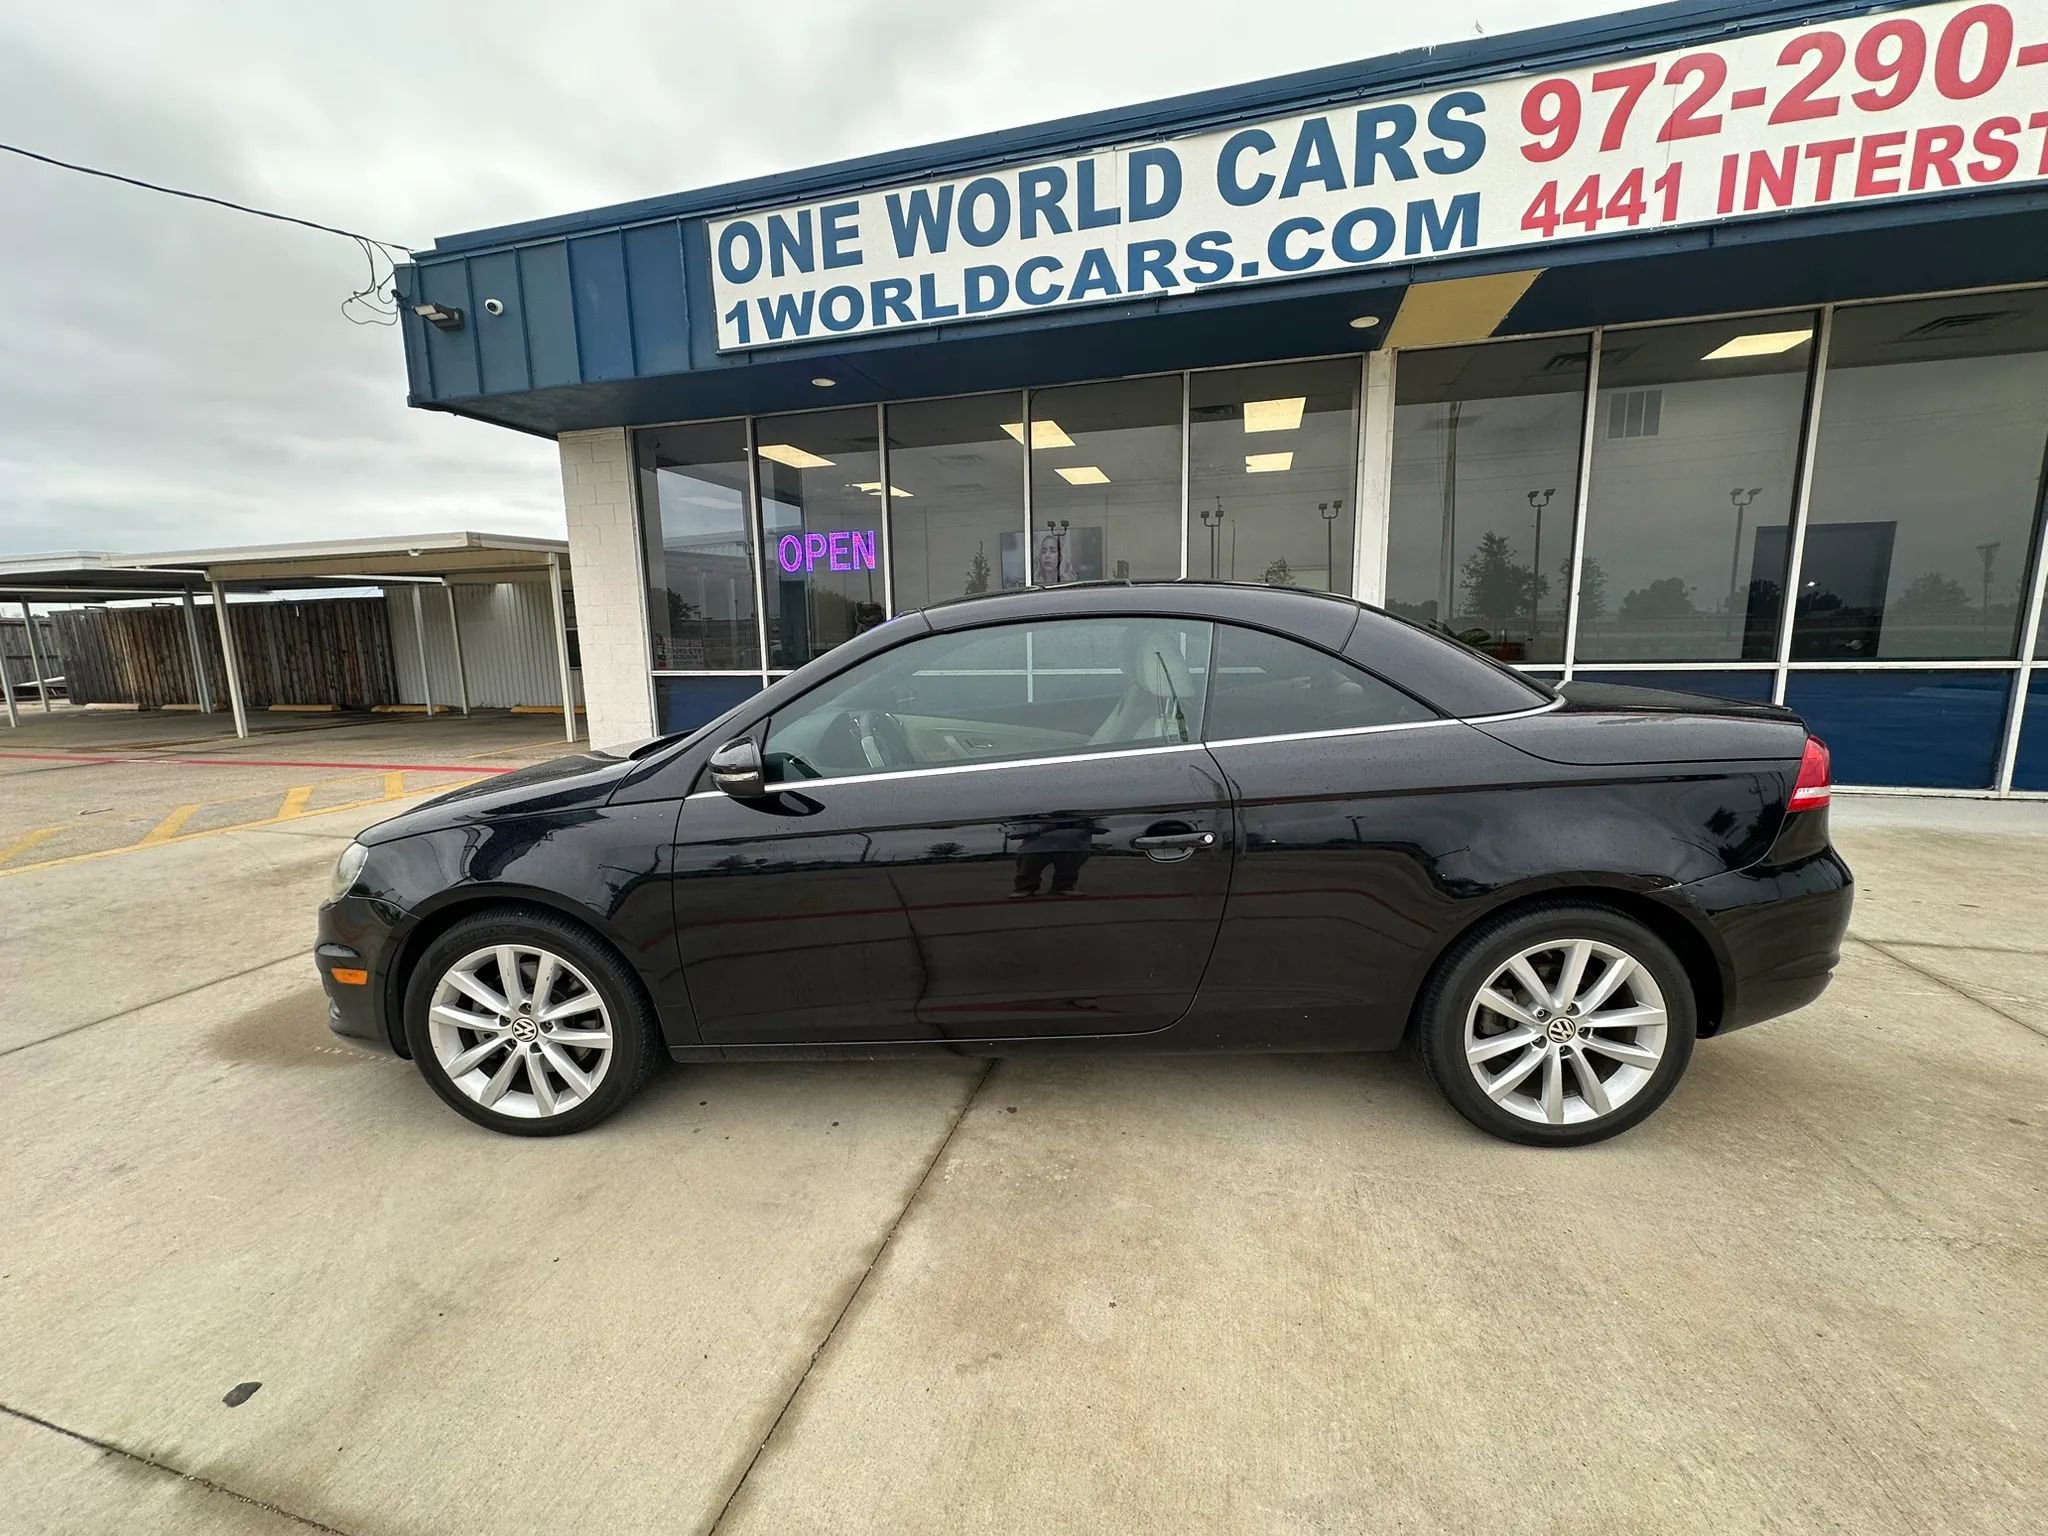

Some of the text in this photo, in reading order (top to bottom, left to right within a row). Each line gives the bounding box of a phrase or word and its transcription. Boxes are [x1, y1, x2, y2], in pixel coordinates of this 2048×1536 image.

[1519, 3, 2048, 165] 972-290-
[718, 91, 1486, 285] ONE WORLD CARS
[1519, 162, 1684, 238] 4441
[725, 192, 1481, 345] 1WORLDCARS.COM
[778, 530, 876, 573] OPEN
